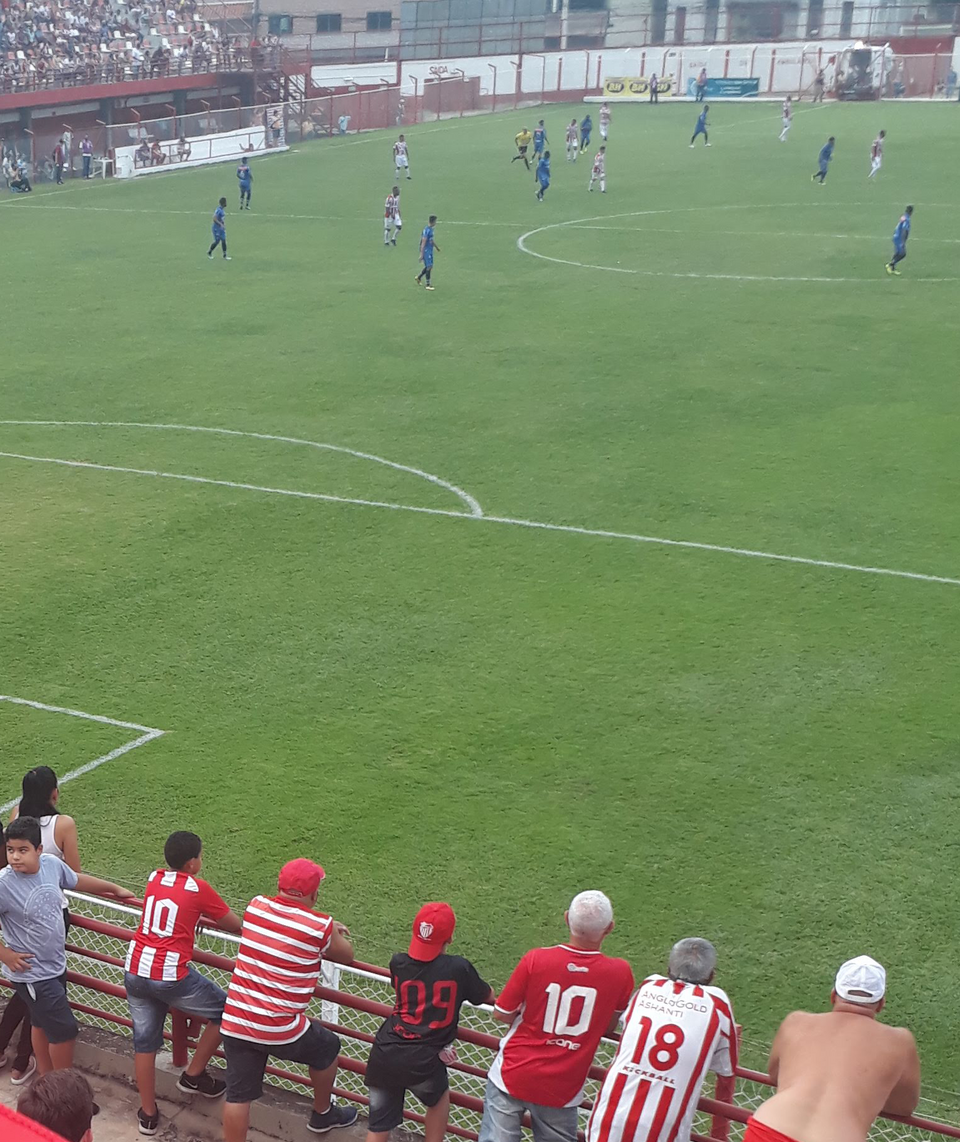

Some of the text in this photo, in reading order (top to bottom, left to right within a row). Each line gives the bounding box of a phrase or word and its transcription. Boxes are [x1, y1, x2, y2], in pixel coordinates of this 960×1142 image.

[142, 895, 179, 938] 10
[542, 982, 597, 1036] 10
[638, 1000, 684, 1019] ASHANTI
[631, 1016, 685, 1071] 18
